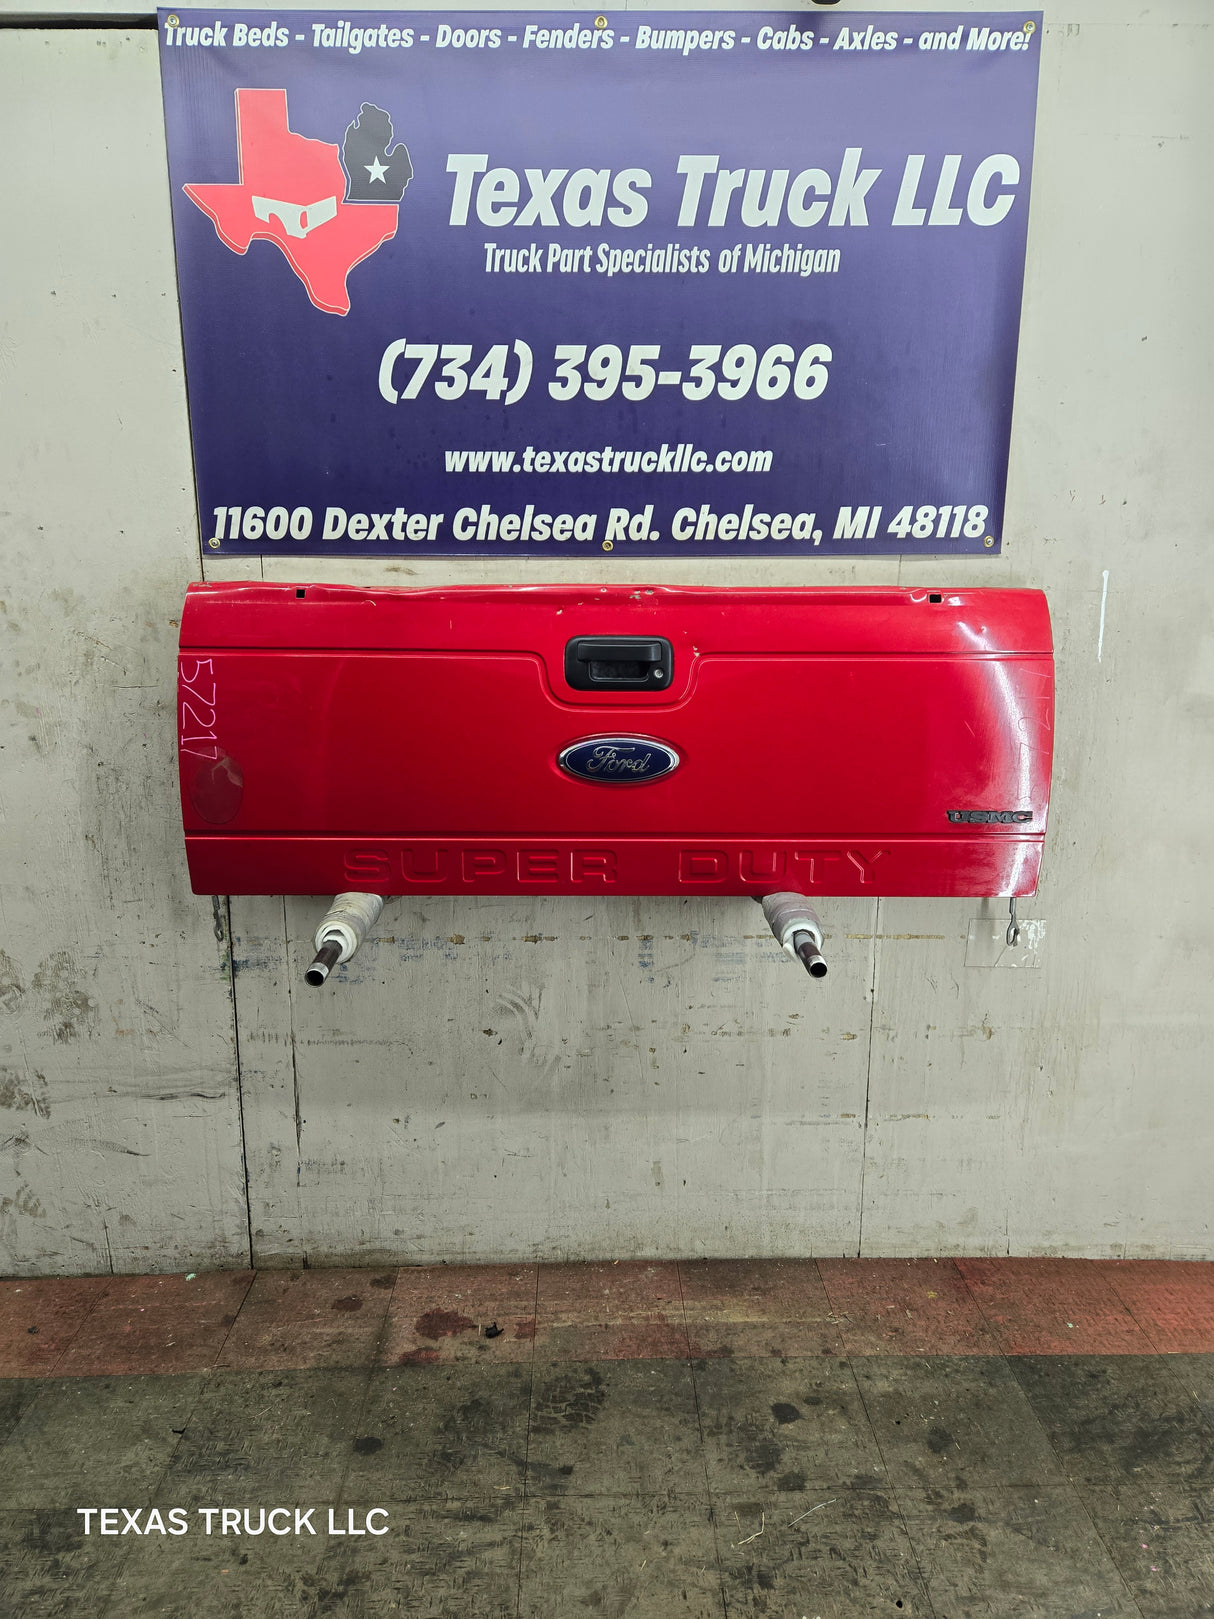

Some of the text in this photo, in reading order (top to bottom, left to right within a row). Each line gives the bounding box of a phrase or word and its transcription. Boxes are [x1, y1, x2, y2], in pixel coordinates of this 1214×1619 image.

[164, 20, 228, 47] Truck
[232, 21, 290, 47] Beds
[311, 20, 415, 55] Tailgates
[435, 24, 502, 49] Doors
[522, 24, 615, 49] Fenders
[634, 25, 736, 56] Bumpers
[756, 24, 815, 50] Cabs
[832, 24, 899, 50] Axles
[918, 24, 964, 51] and
[965, 25, 1033, 51] More!
[445, 147, 1021, 228] Texas Truck LLC
[484, 242, 841, 277] Truck Part Specialists of Michigan
[378, 338, 833, 406] (734) 395-3966
[445, 443, 773, 473] www.texastruckllc.com
[212, 504, 989, 546] 11600 Dexter Chelsea Rd. Chelsea, MI 48118
[179, 657, 219, 761] 57217
[586, 745, 652, 772] Ford
[946, 810, 1034, 825] USMC
[343, 847, 891, 884] SUPER DUTY
